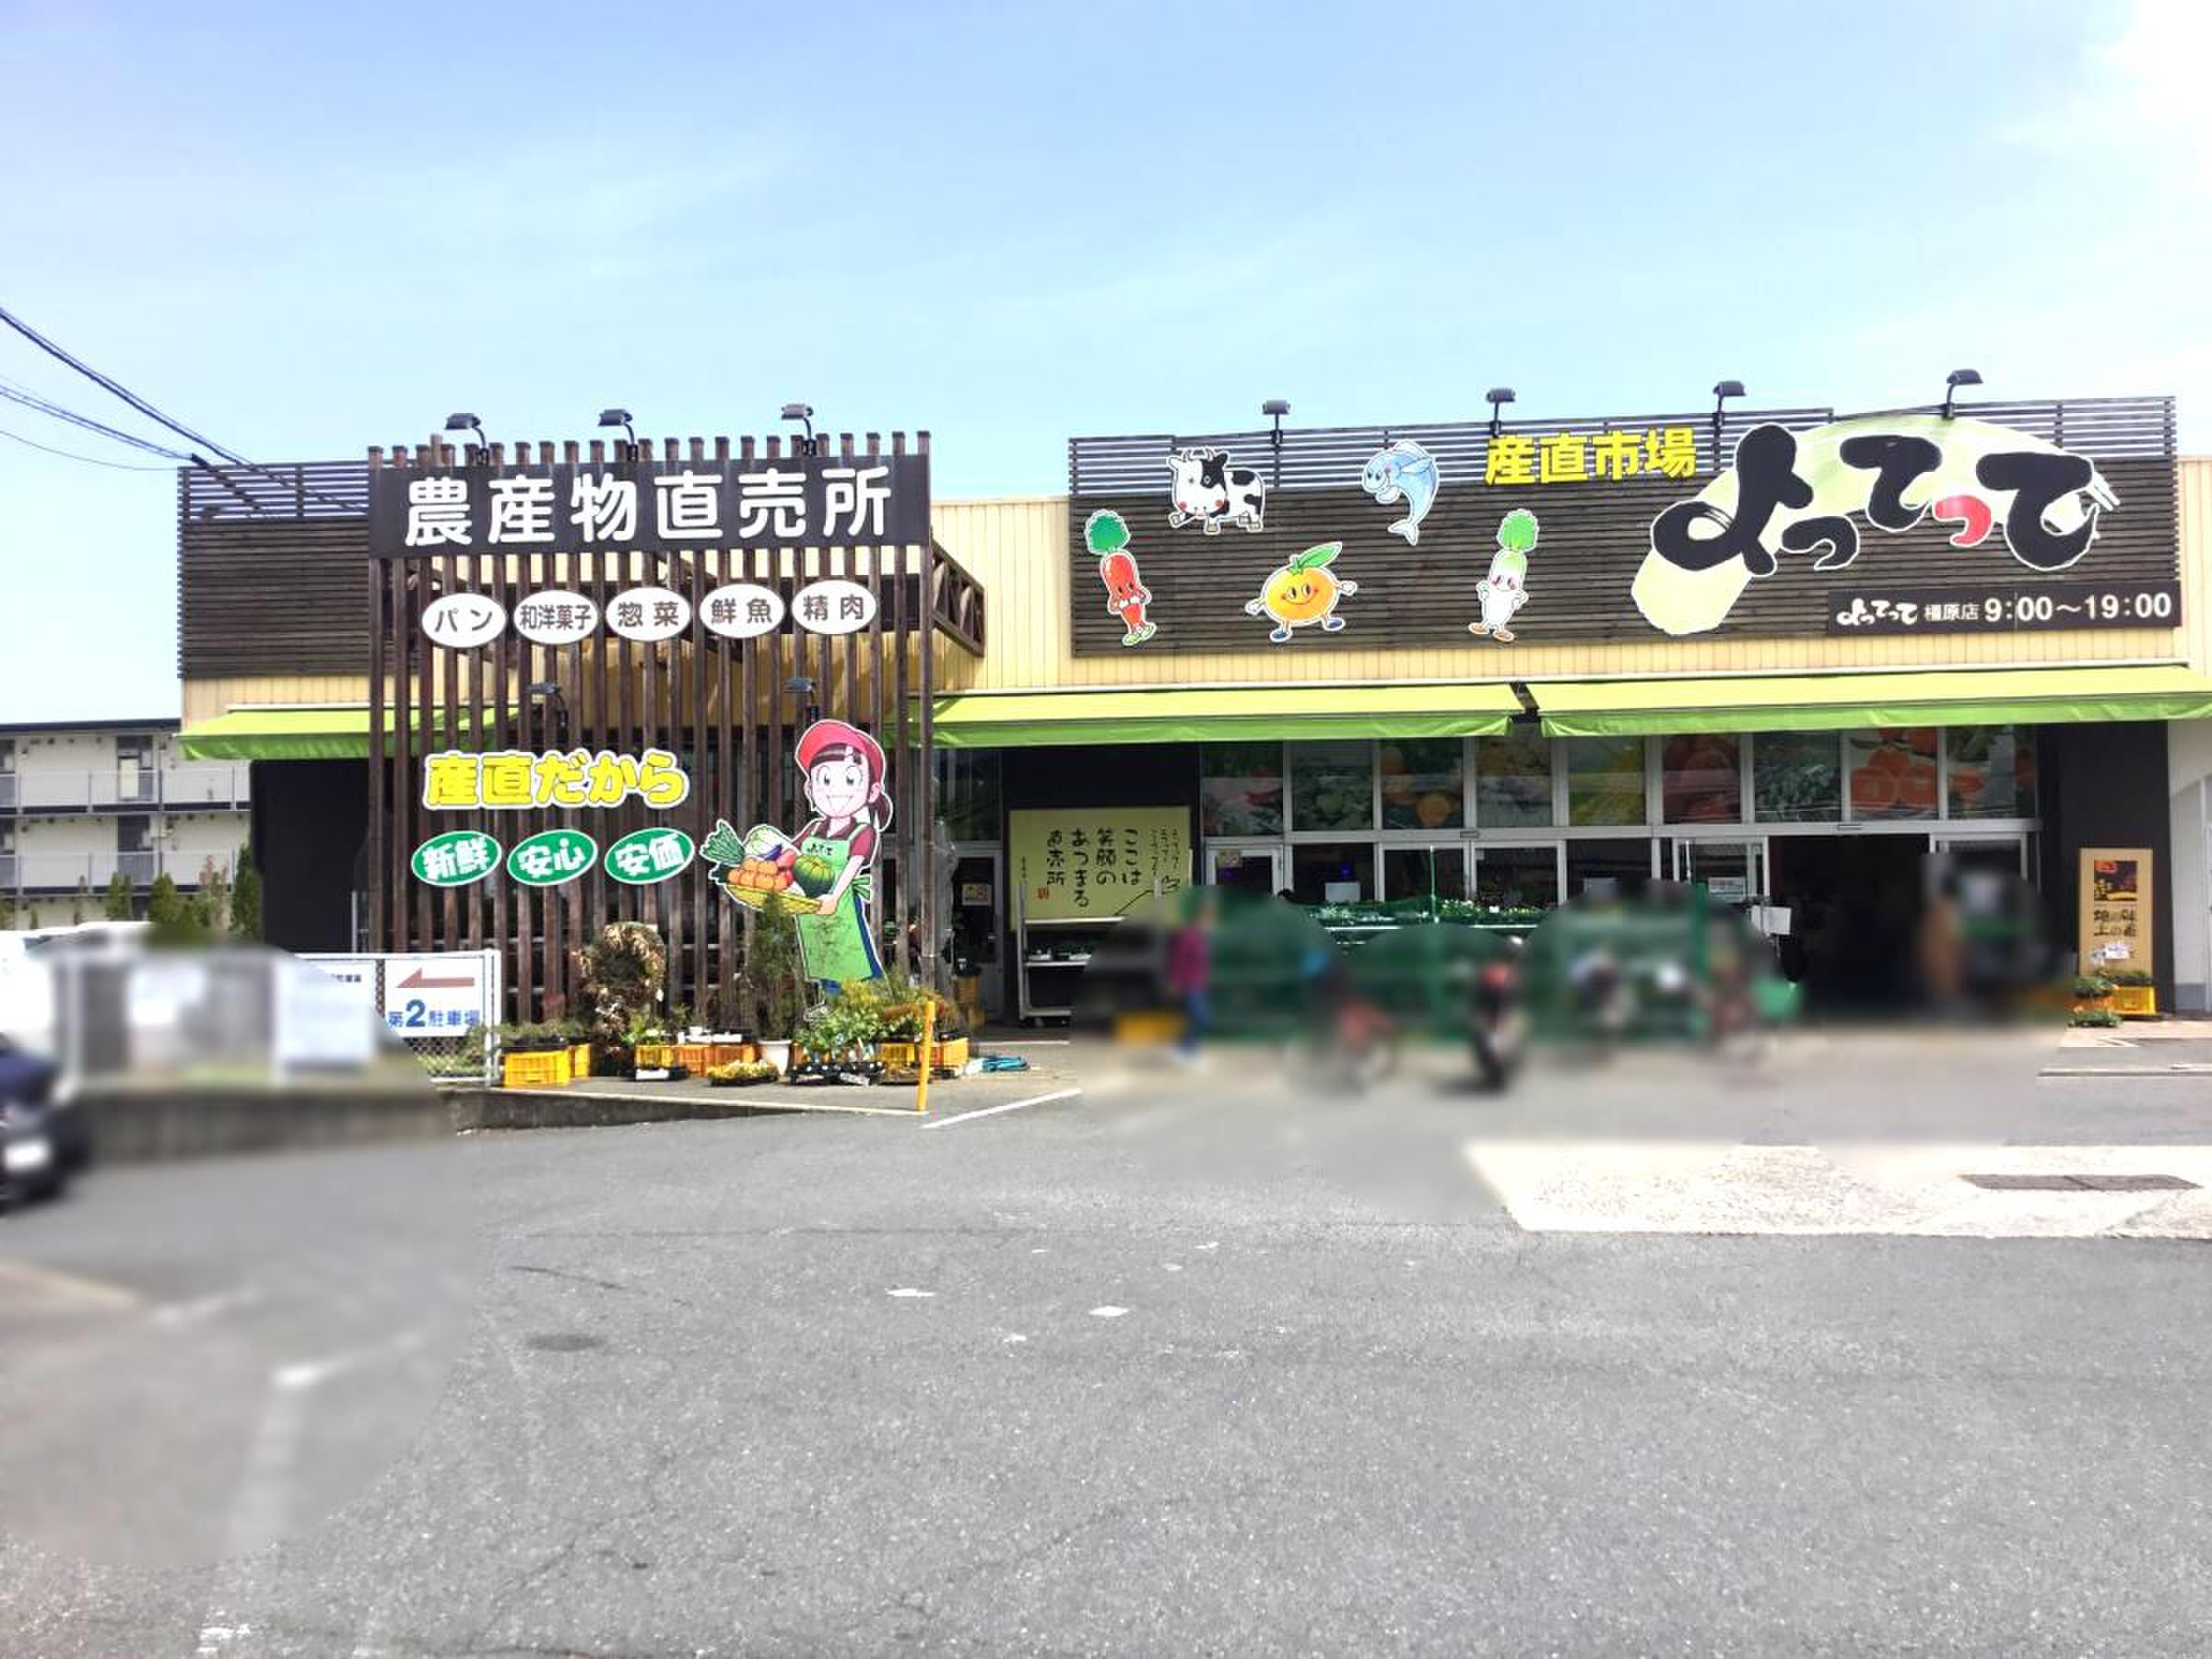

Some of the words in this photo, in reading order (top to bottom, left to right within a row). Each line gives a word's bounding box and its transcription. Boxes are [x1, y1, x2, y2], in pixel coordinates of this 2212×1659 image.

[1485, 428, 1697, 486] 産直市場
[404, 465, 893, 547] 農産物直売所
[1652, 423, 2100, 577] よってって
[434, 607, 494, 632] パン
[519, 603, 593, 629] 和洋菓子
[618, 600, 680, 628] 惣菜
[711, 596, 774, 625] 鮮魚
[803, 594, 865, 621] 精肉
[425, 750, 688, 807] 産直だから
[422, 836, 490, 880] 新鮮
[516, 838, 586, 878] 安心
[615, 832, 686, 877] 安価
[1071, 828, 1091, 908] あつまる
